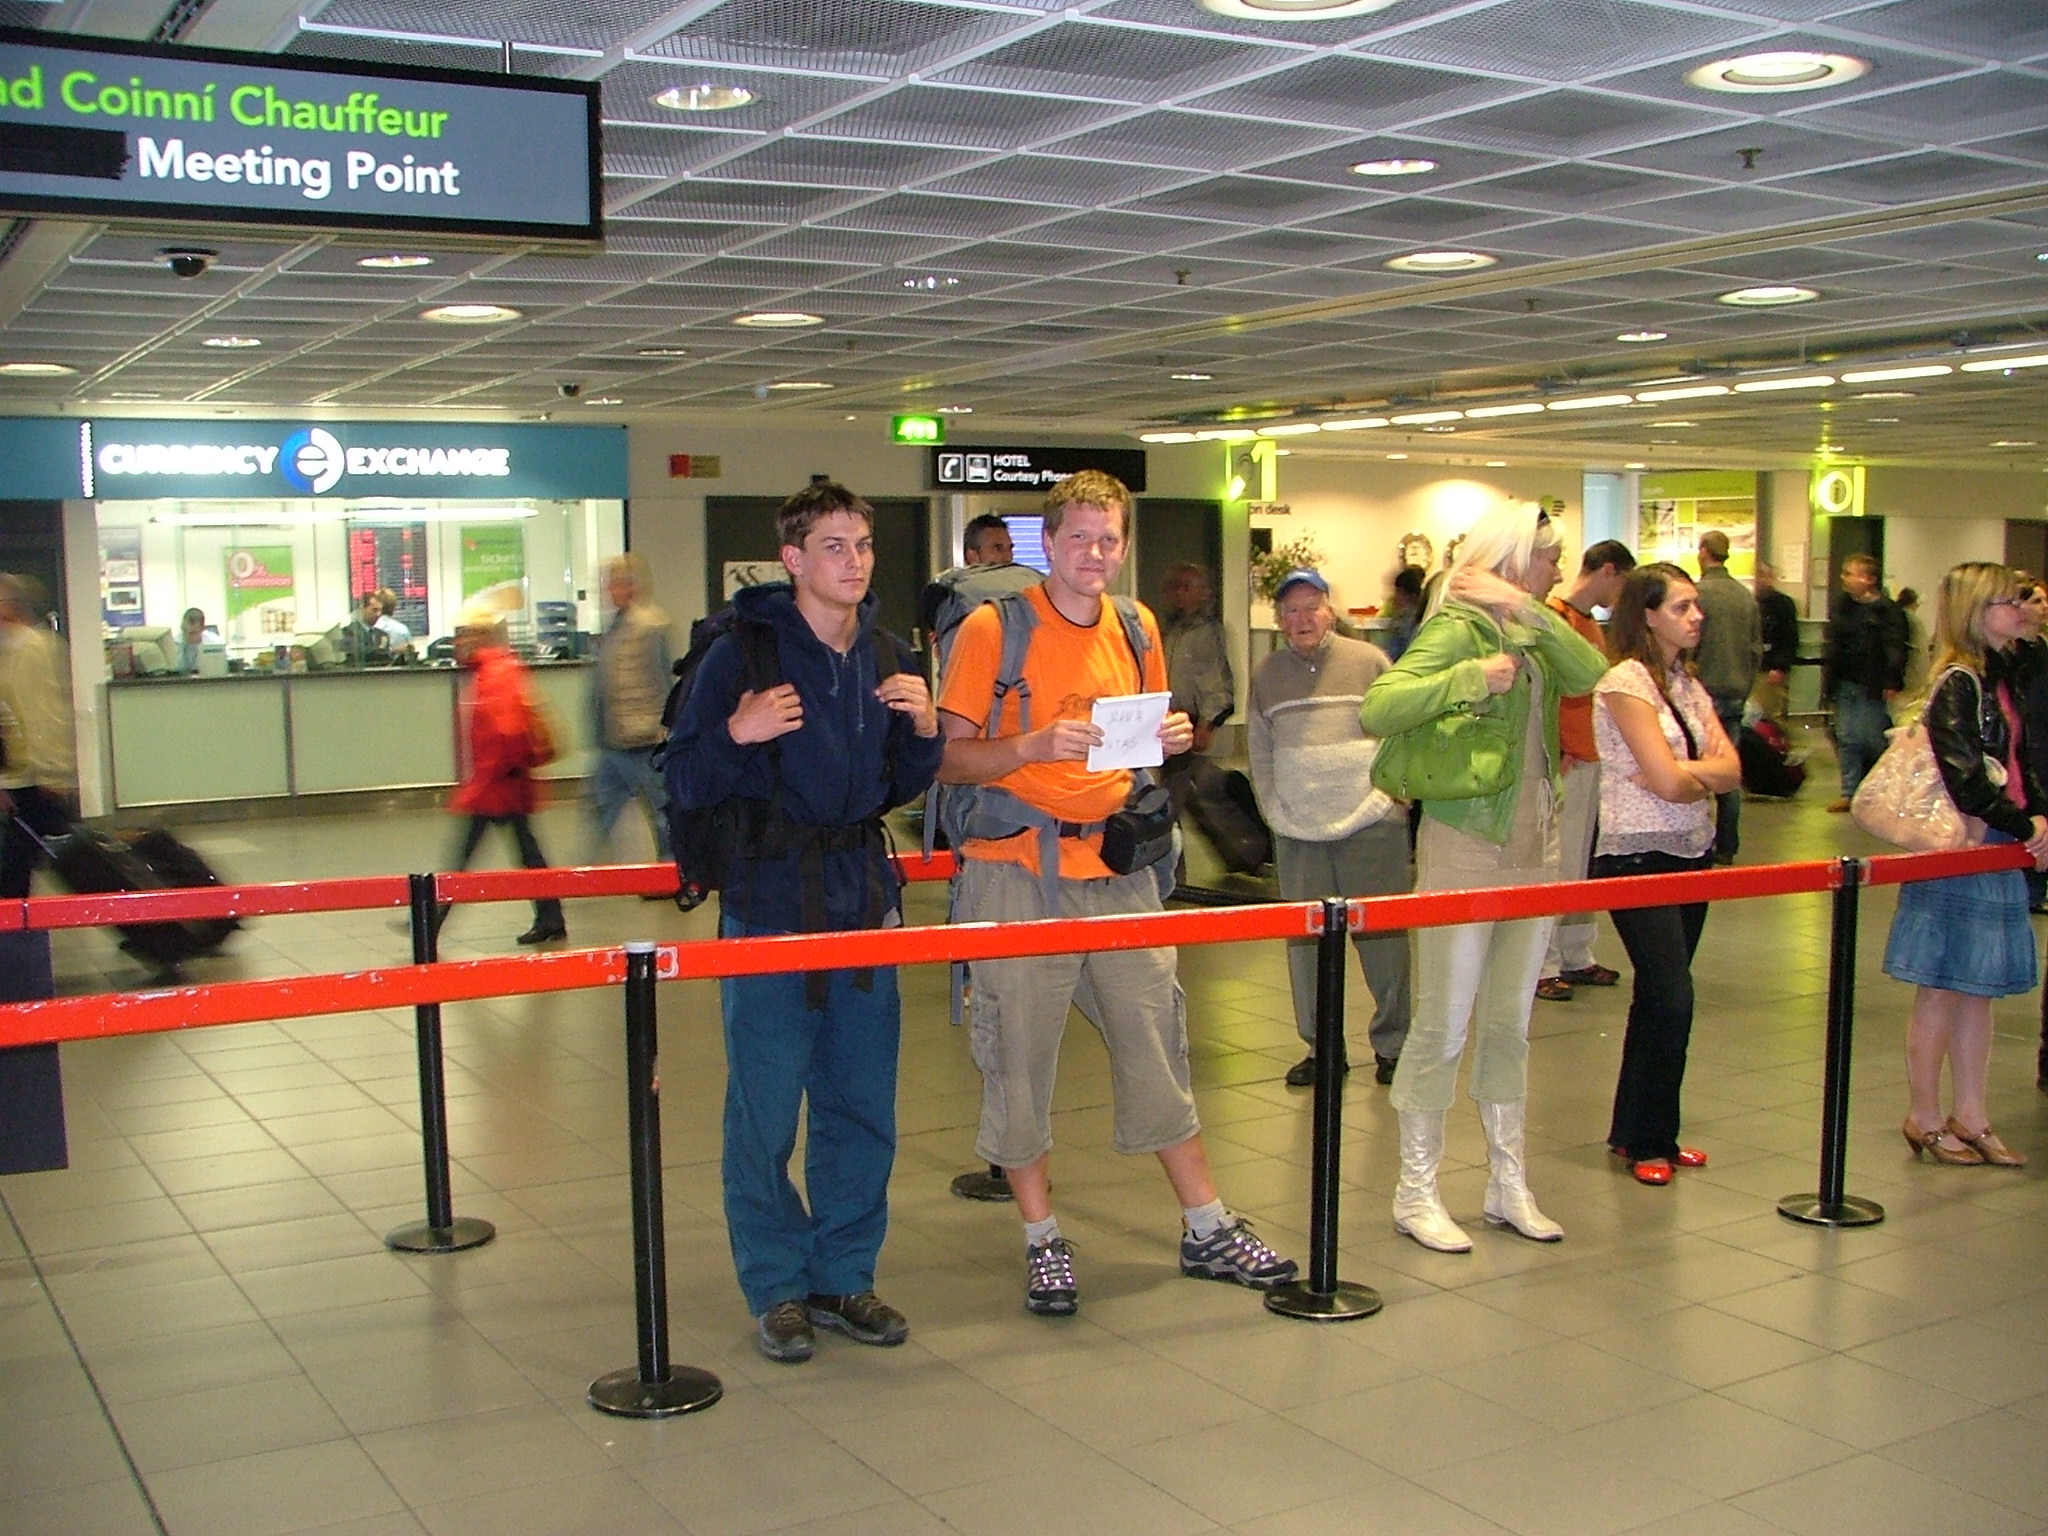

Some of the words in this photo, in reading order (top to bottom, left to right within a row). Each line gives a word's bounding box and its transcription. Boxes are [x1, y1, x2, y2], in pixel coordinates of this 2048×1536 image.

[61, 71, 217, 122] Coinní
[229, 84, 449, 138] Chauffeur
[138, 137, 331, 199] Meeting
[347, 151, 461, 195] Point
[99, 443, 279, 475] CURRENCY
[346, 447, 511, 476] EXCHANGE
[993, 454, 1031, 467] HOTEL
[993, 469, 1040, 485] Courtesy
